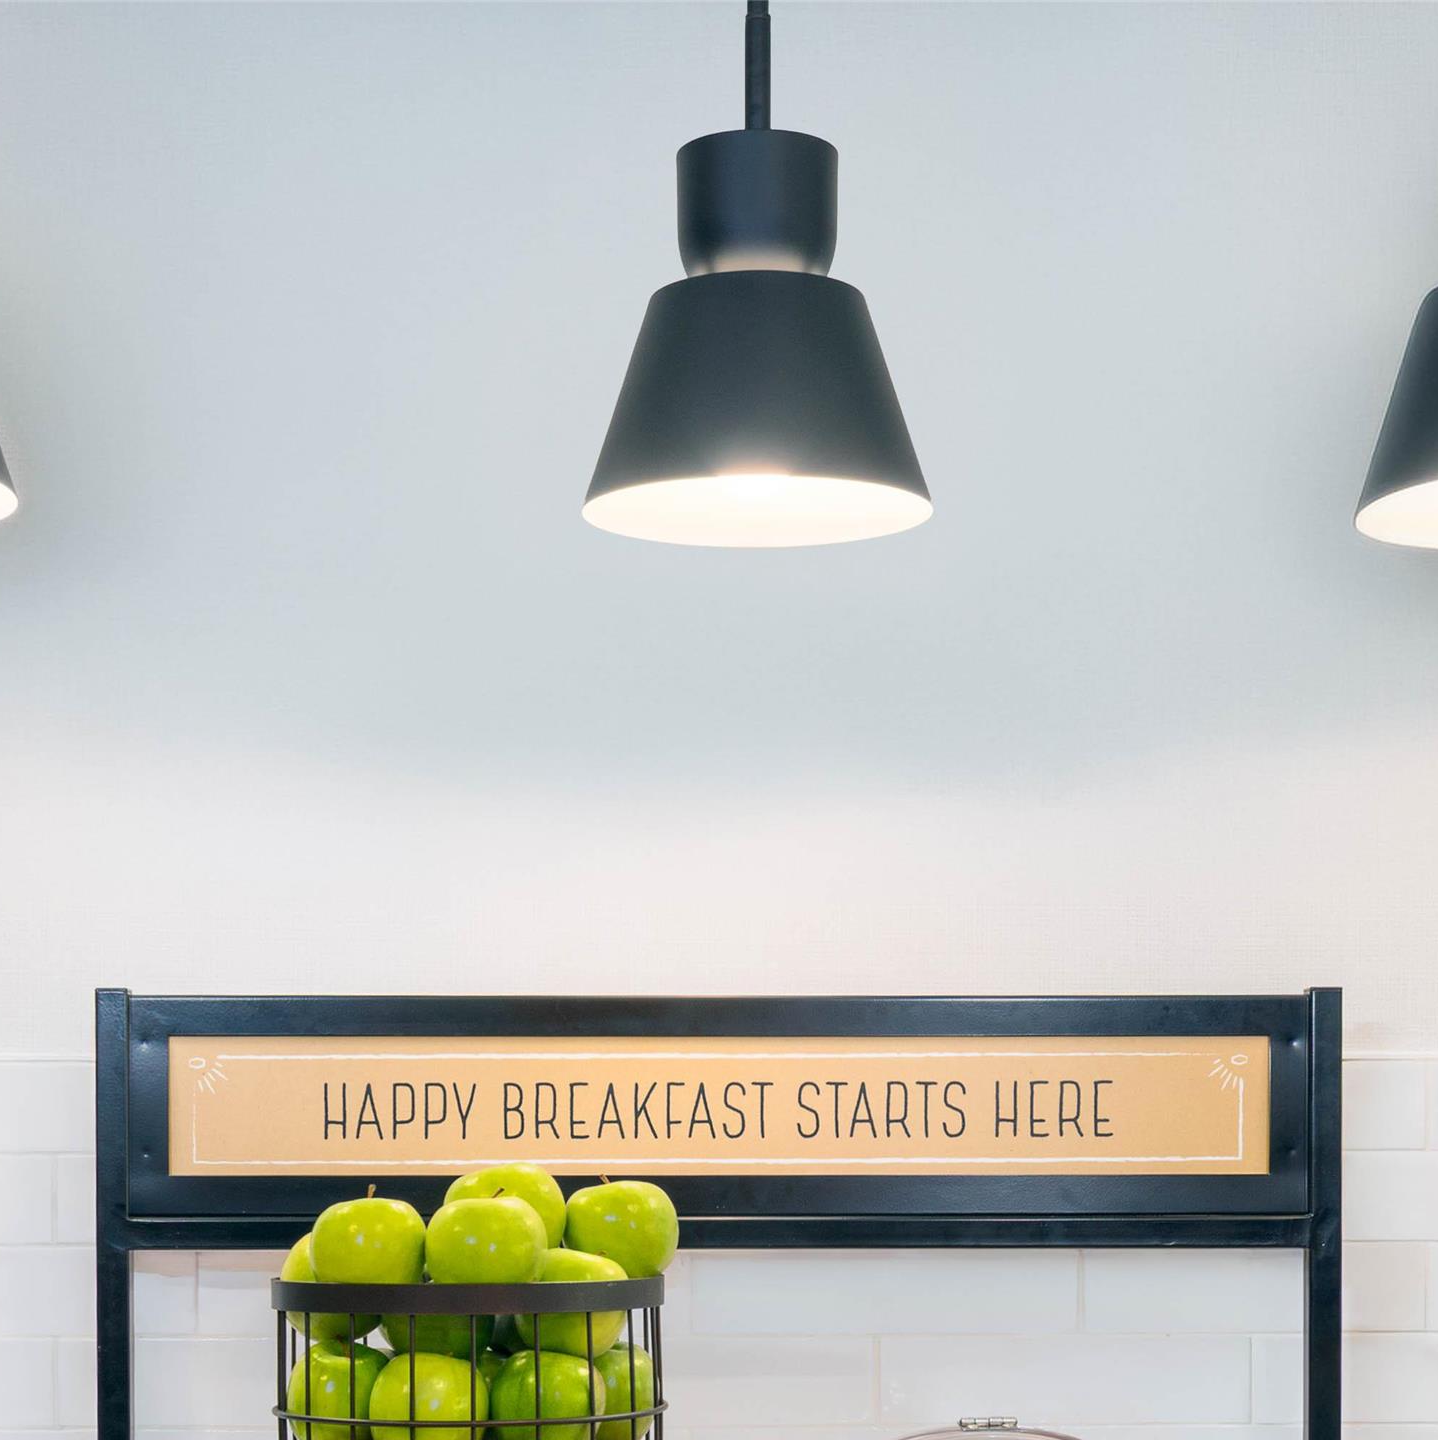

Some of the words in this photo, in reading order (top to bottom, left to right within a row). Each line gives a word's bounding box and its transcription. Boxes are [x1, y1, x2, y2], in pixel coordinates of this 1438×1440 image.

[322, 1081, 477, 1141] HAPPY
[502, 1081, 775, 1141] BREAKFAST
[796, 1080, 967, 1140] STARTS
[995, 1079, 1115, 1139] HERE
